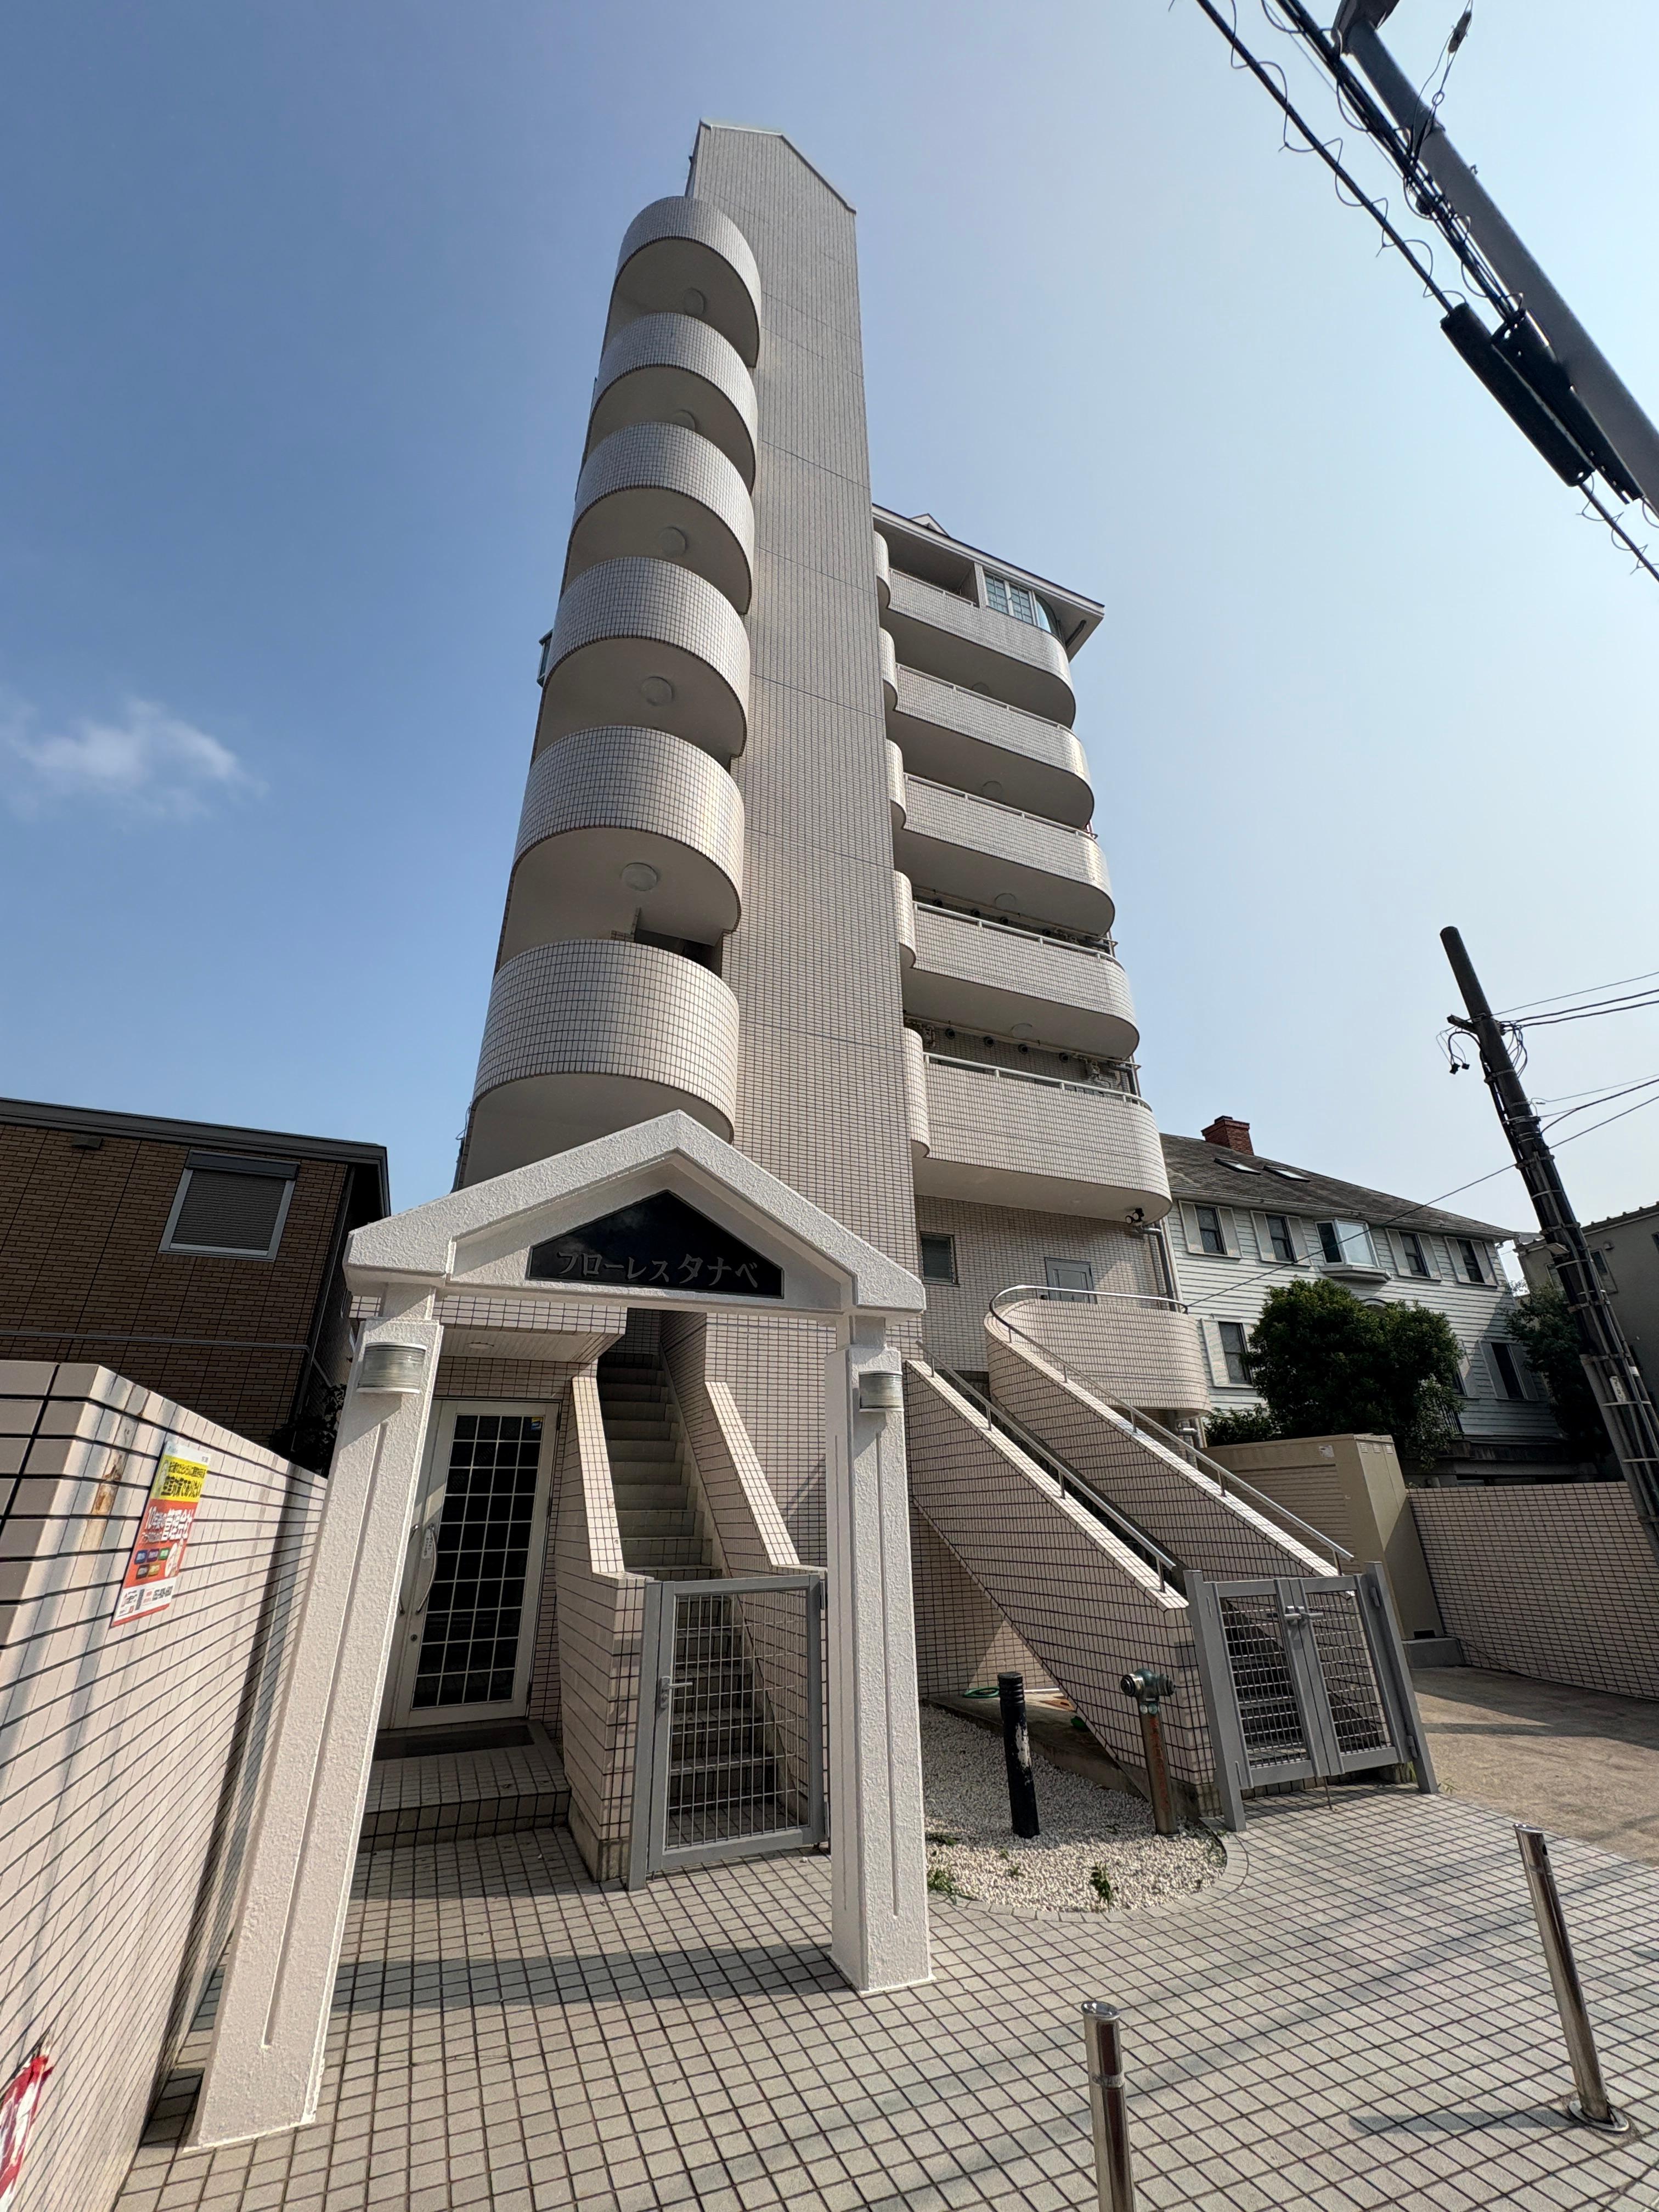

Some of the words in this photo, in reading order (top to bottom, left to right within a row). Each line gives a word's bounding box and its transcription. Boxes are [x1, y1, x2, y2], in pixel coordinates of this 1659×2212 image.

[557, 1251, 758, 1288] フローレスタナベ
